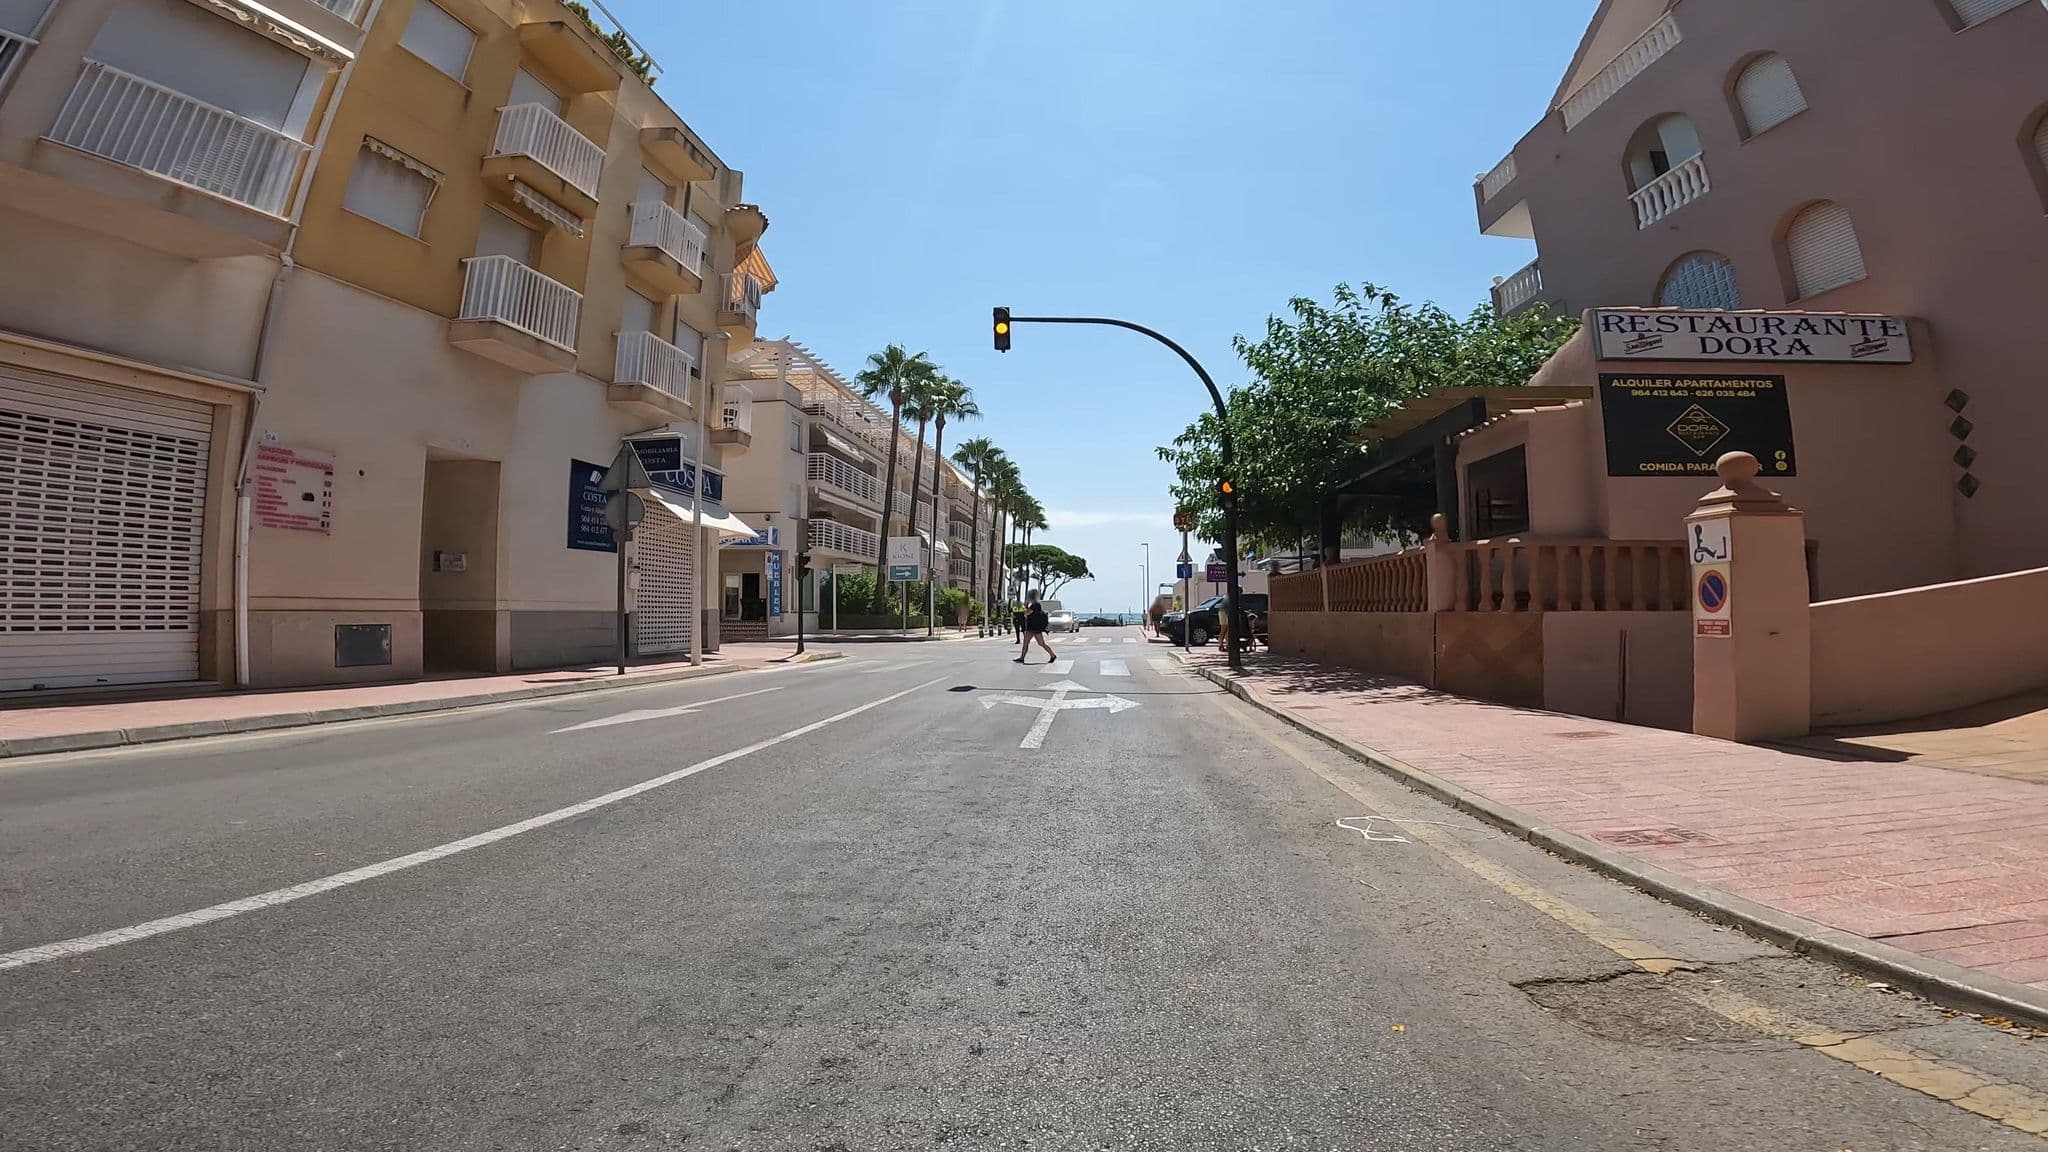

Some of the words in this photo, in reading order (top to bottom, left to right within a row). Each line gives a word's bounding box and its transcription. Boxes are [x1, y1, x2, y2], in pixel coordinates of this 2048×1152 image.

[1601, 314, 1903, 337] RESTAURANTE
[1698, 336, 1815, 357] DORA
[1611, 378, 1672, 388] ALQUILER
[1675, 379, 1774, 389] APARTAMENTOS
[1652, 389, 1668, 397] 412
[1677, 424, 1719, 432] DORA
[1640, 463, 1685, 471] COMIDA
[1687, 463, 1717, 471] PARA
[665, 469, 712, 495] COSA
[583, 491, 608, 504] COSTA
[772, 553, 781, 613] MUEBLES
